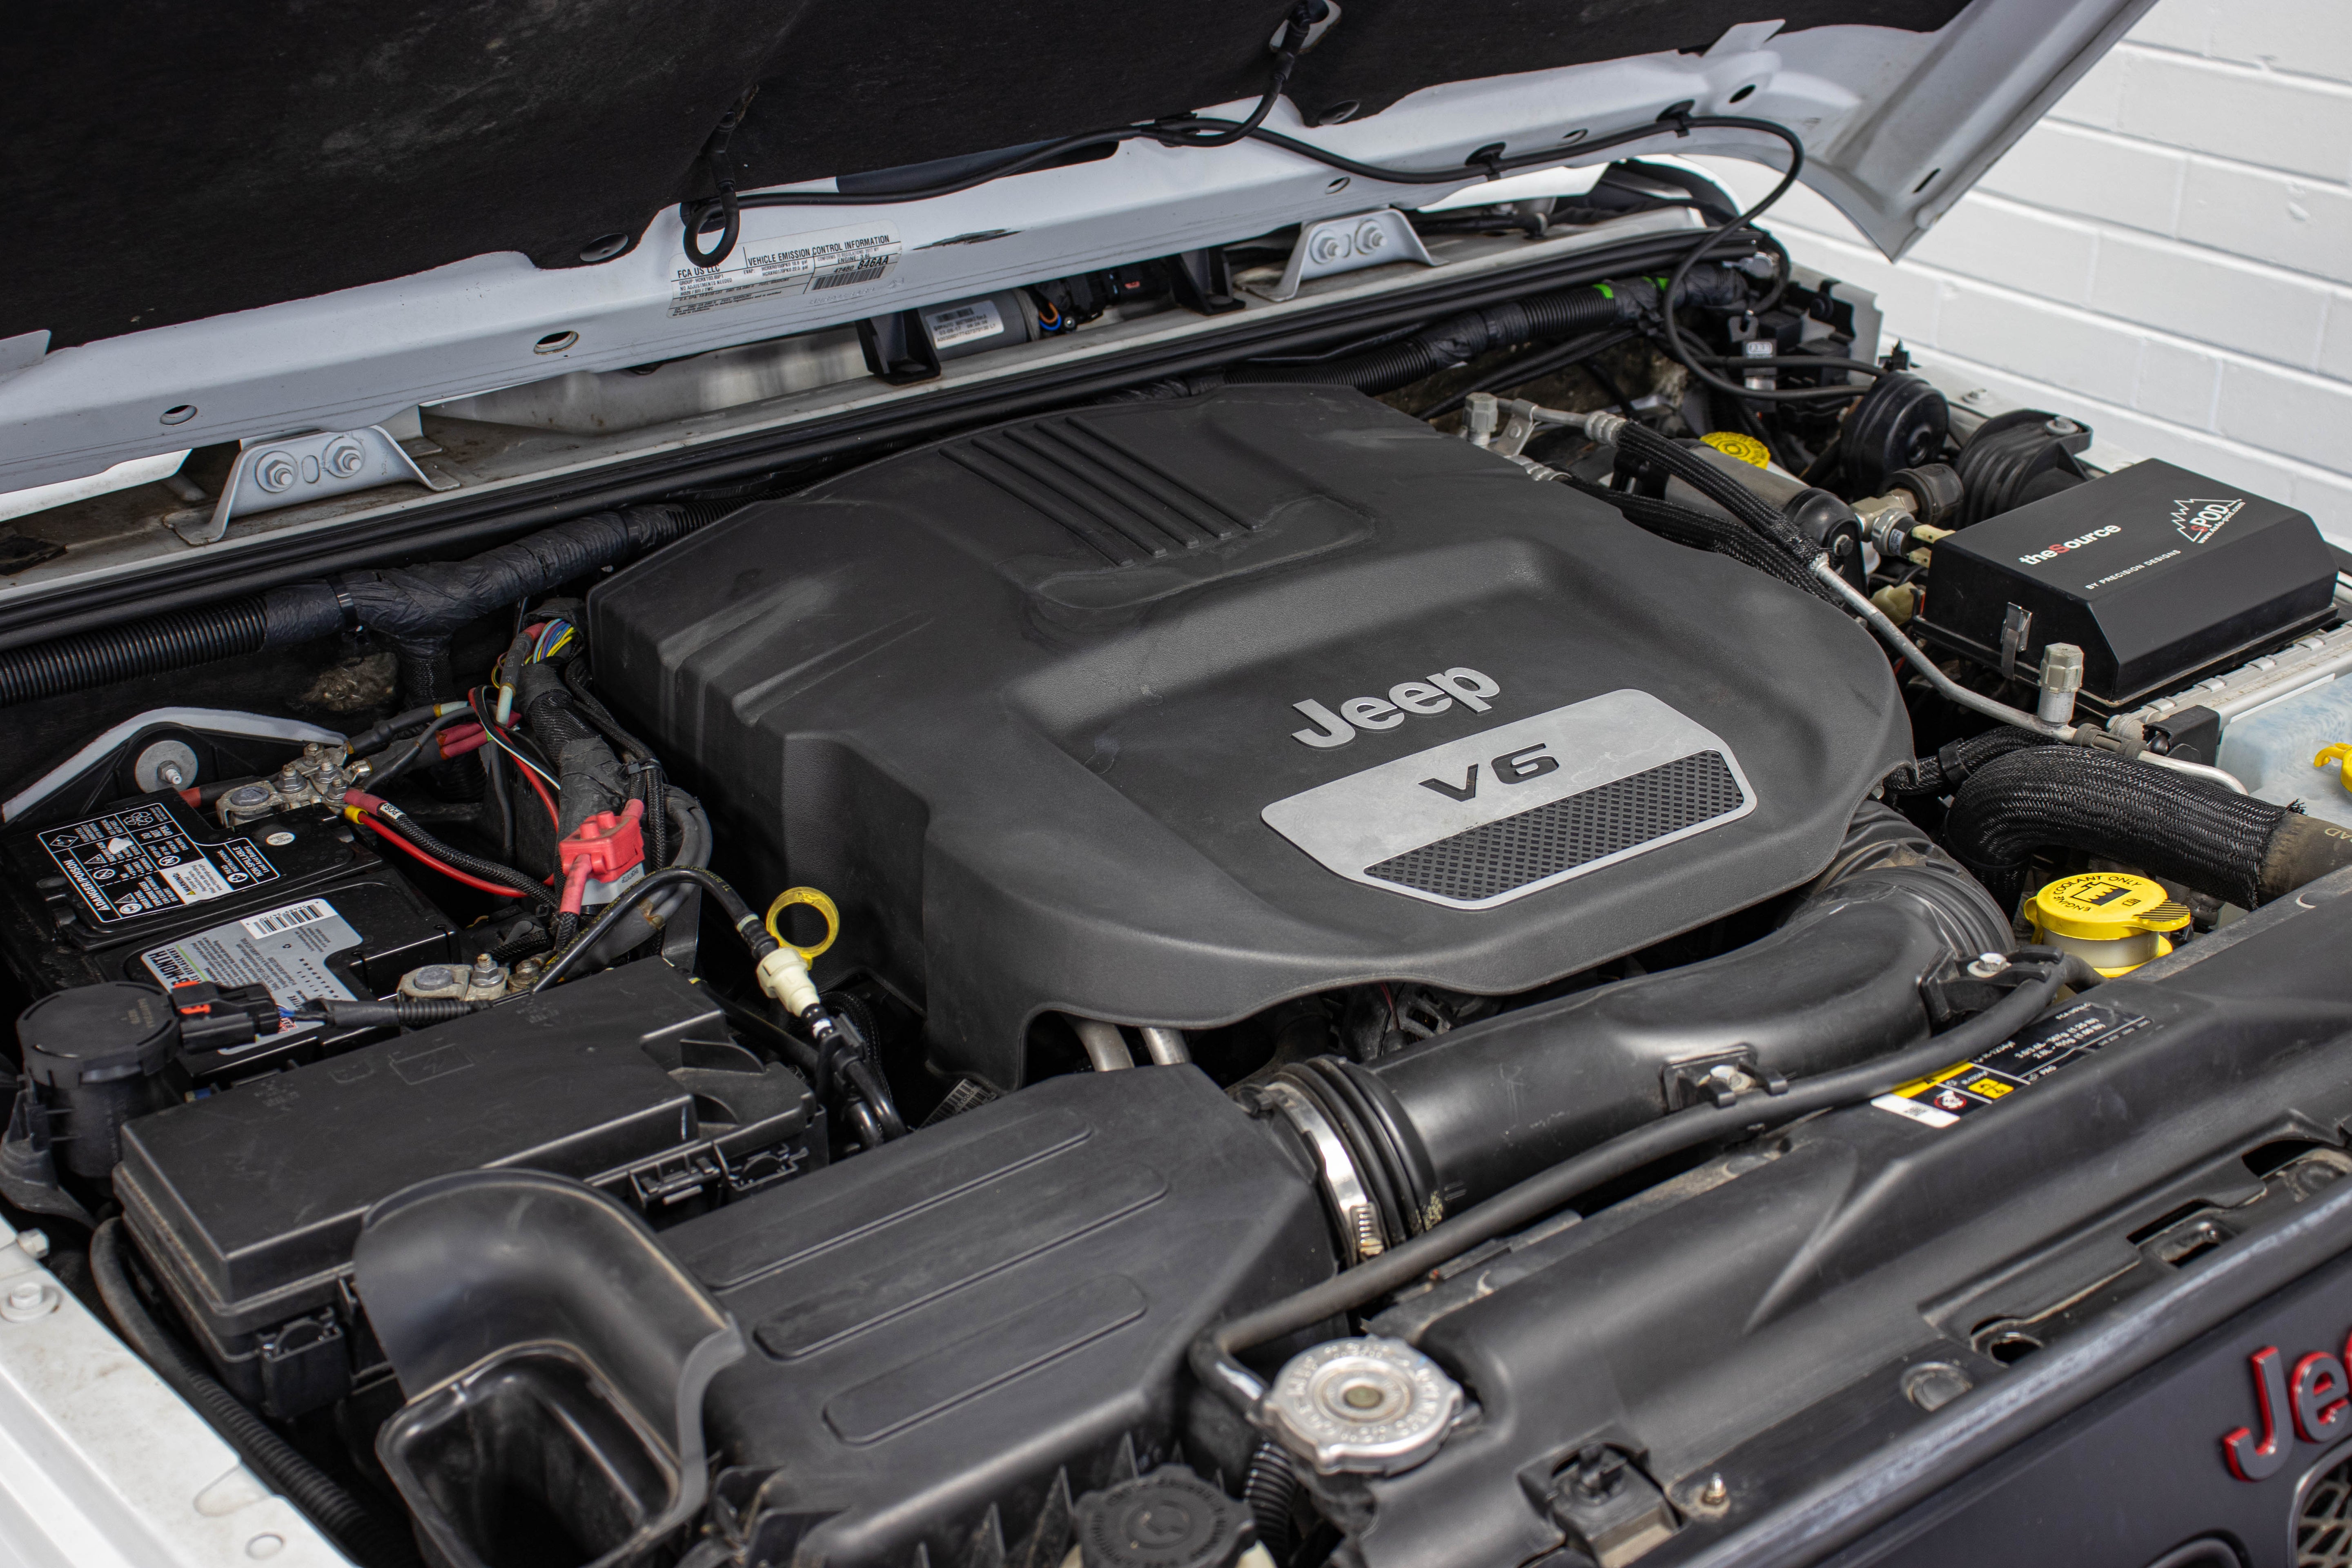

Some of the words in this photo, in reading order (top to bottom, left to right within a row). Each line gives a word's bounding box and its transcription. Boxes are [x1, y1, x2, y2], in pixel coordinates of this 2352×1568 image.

[748, 254, 776, 266] VEHICLE
[778, 248, 810, 261] EMISSION
[812, 243, 843, 255] CONTROL
[844, 235, 889, 249] INFORMATION
[837, 256, 859, 264] ENGINE:
[858, 256, 889, 270] 846AA
[677, 269, 692, 278] FCA
[694, 267, 705, 276] US
[687, 281, 716, 290] ADJUSTMENTS
[2189, 504, 2229, 532] sPOD
[2018, 525, 2121, 565] theSource
[2098, 564, 2145, 584] PRECISION
[2143, 550, 2181, 566] DESIGNS
[1292, 667, 1500, 750] Jeep
[1418, 742, 1560, 802] V6
[99, 819, 113, 830] MEDICAL
[157, 824, 174, 836] OPEN.
[79, 833, 91, 842] FLUSH
[80, 824, 98, 840] IMMEDIATELY
[149, 829, 163, 837] NOT
[2324, 828, 2352, 843] AD
[167, 843, 180, 853] REACH
[173, 837, 189, 850] CHILDREN.
[100, 848, 118, 862] SULFURIC
[242, 846, 258, 858] Battery
[216, 849, 240, 872] INSTRUCTIONS.
[232, 846, 264, 877] NON-SPILLABLE
[220, 864, 233, 874] READ
[258, 864, 270, 872] Lead
[62, 858, 107, 906] DANGER/POISON
[137, 881, 152, 891] GASES
[143, 875, 160, 890] BLINDNESS
[171, 872, 192, 892] WARNING:
[2054, 876, 2103, 895] COOLANT
[2109, 876, 2143, 886] ONLY
[132, 889, 146, 899] EYES.
[145, 890, 163, 906] EXPLOSIVE
[154, 889, 167, 898] CAUSE
[138, 898, 154, 909] SHIELD
[2054, 895, 2091, 911] ENGINE
[166, 947, 195, 975] REPLACEMENT
[2223, 1324, 2352, 1483] Je
